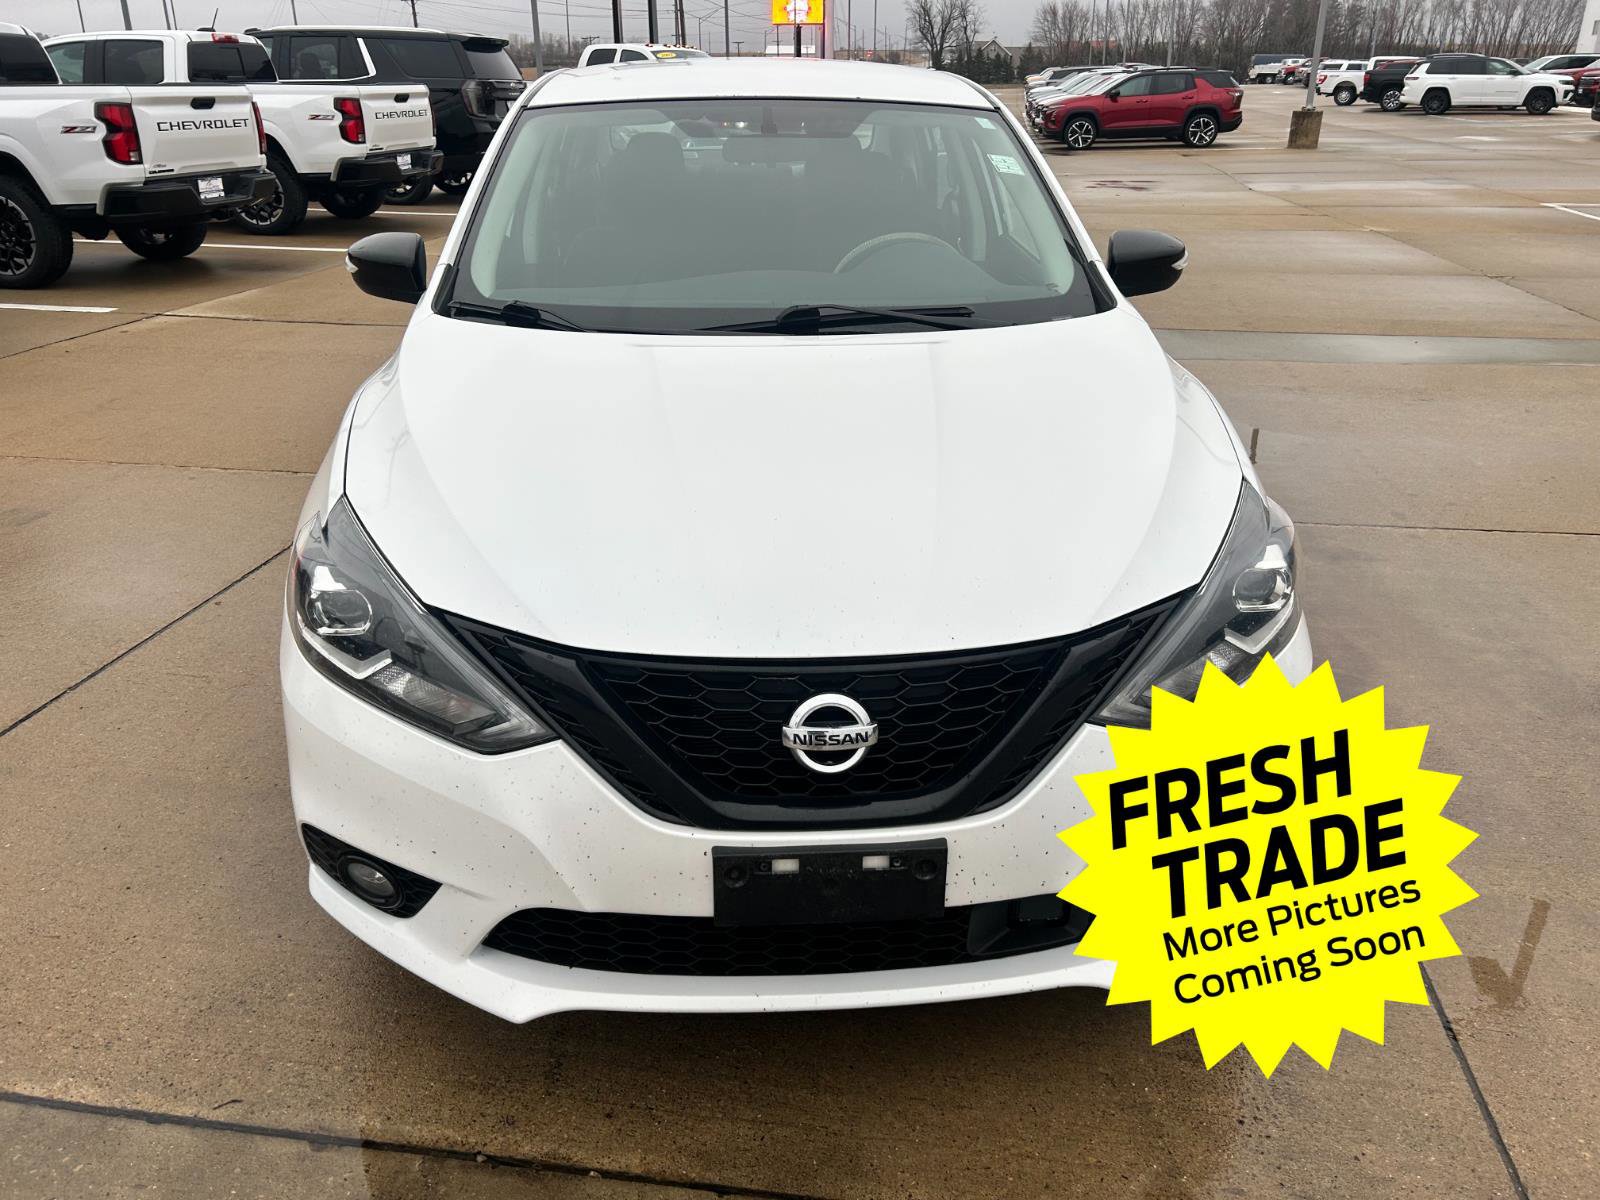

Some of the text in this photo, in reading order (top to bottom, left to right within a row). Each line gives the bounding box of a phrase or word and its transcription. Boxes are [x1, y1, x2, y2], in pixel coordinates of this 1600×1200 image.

[375, 110, 428, 120] CHEVROLET
[156, 118, 250, 132] CHEVROLET
[792, 731, 869, 746] NISSAN
